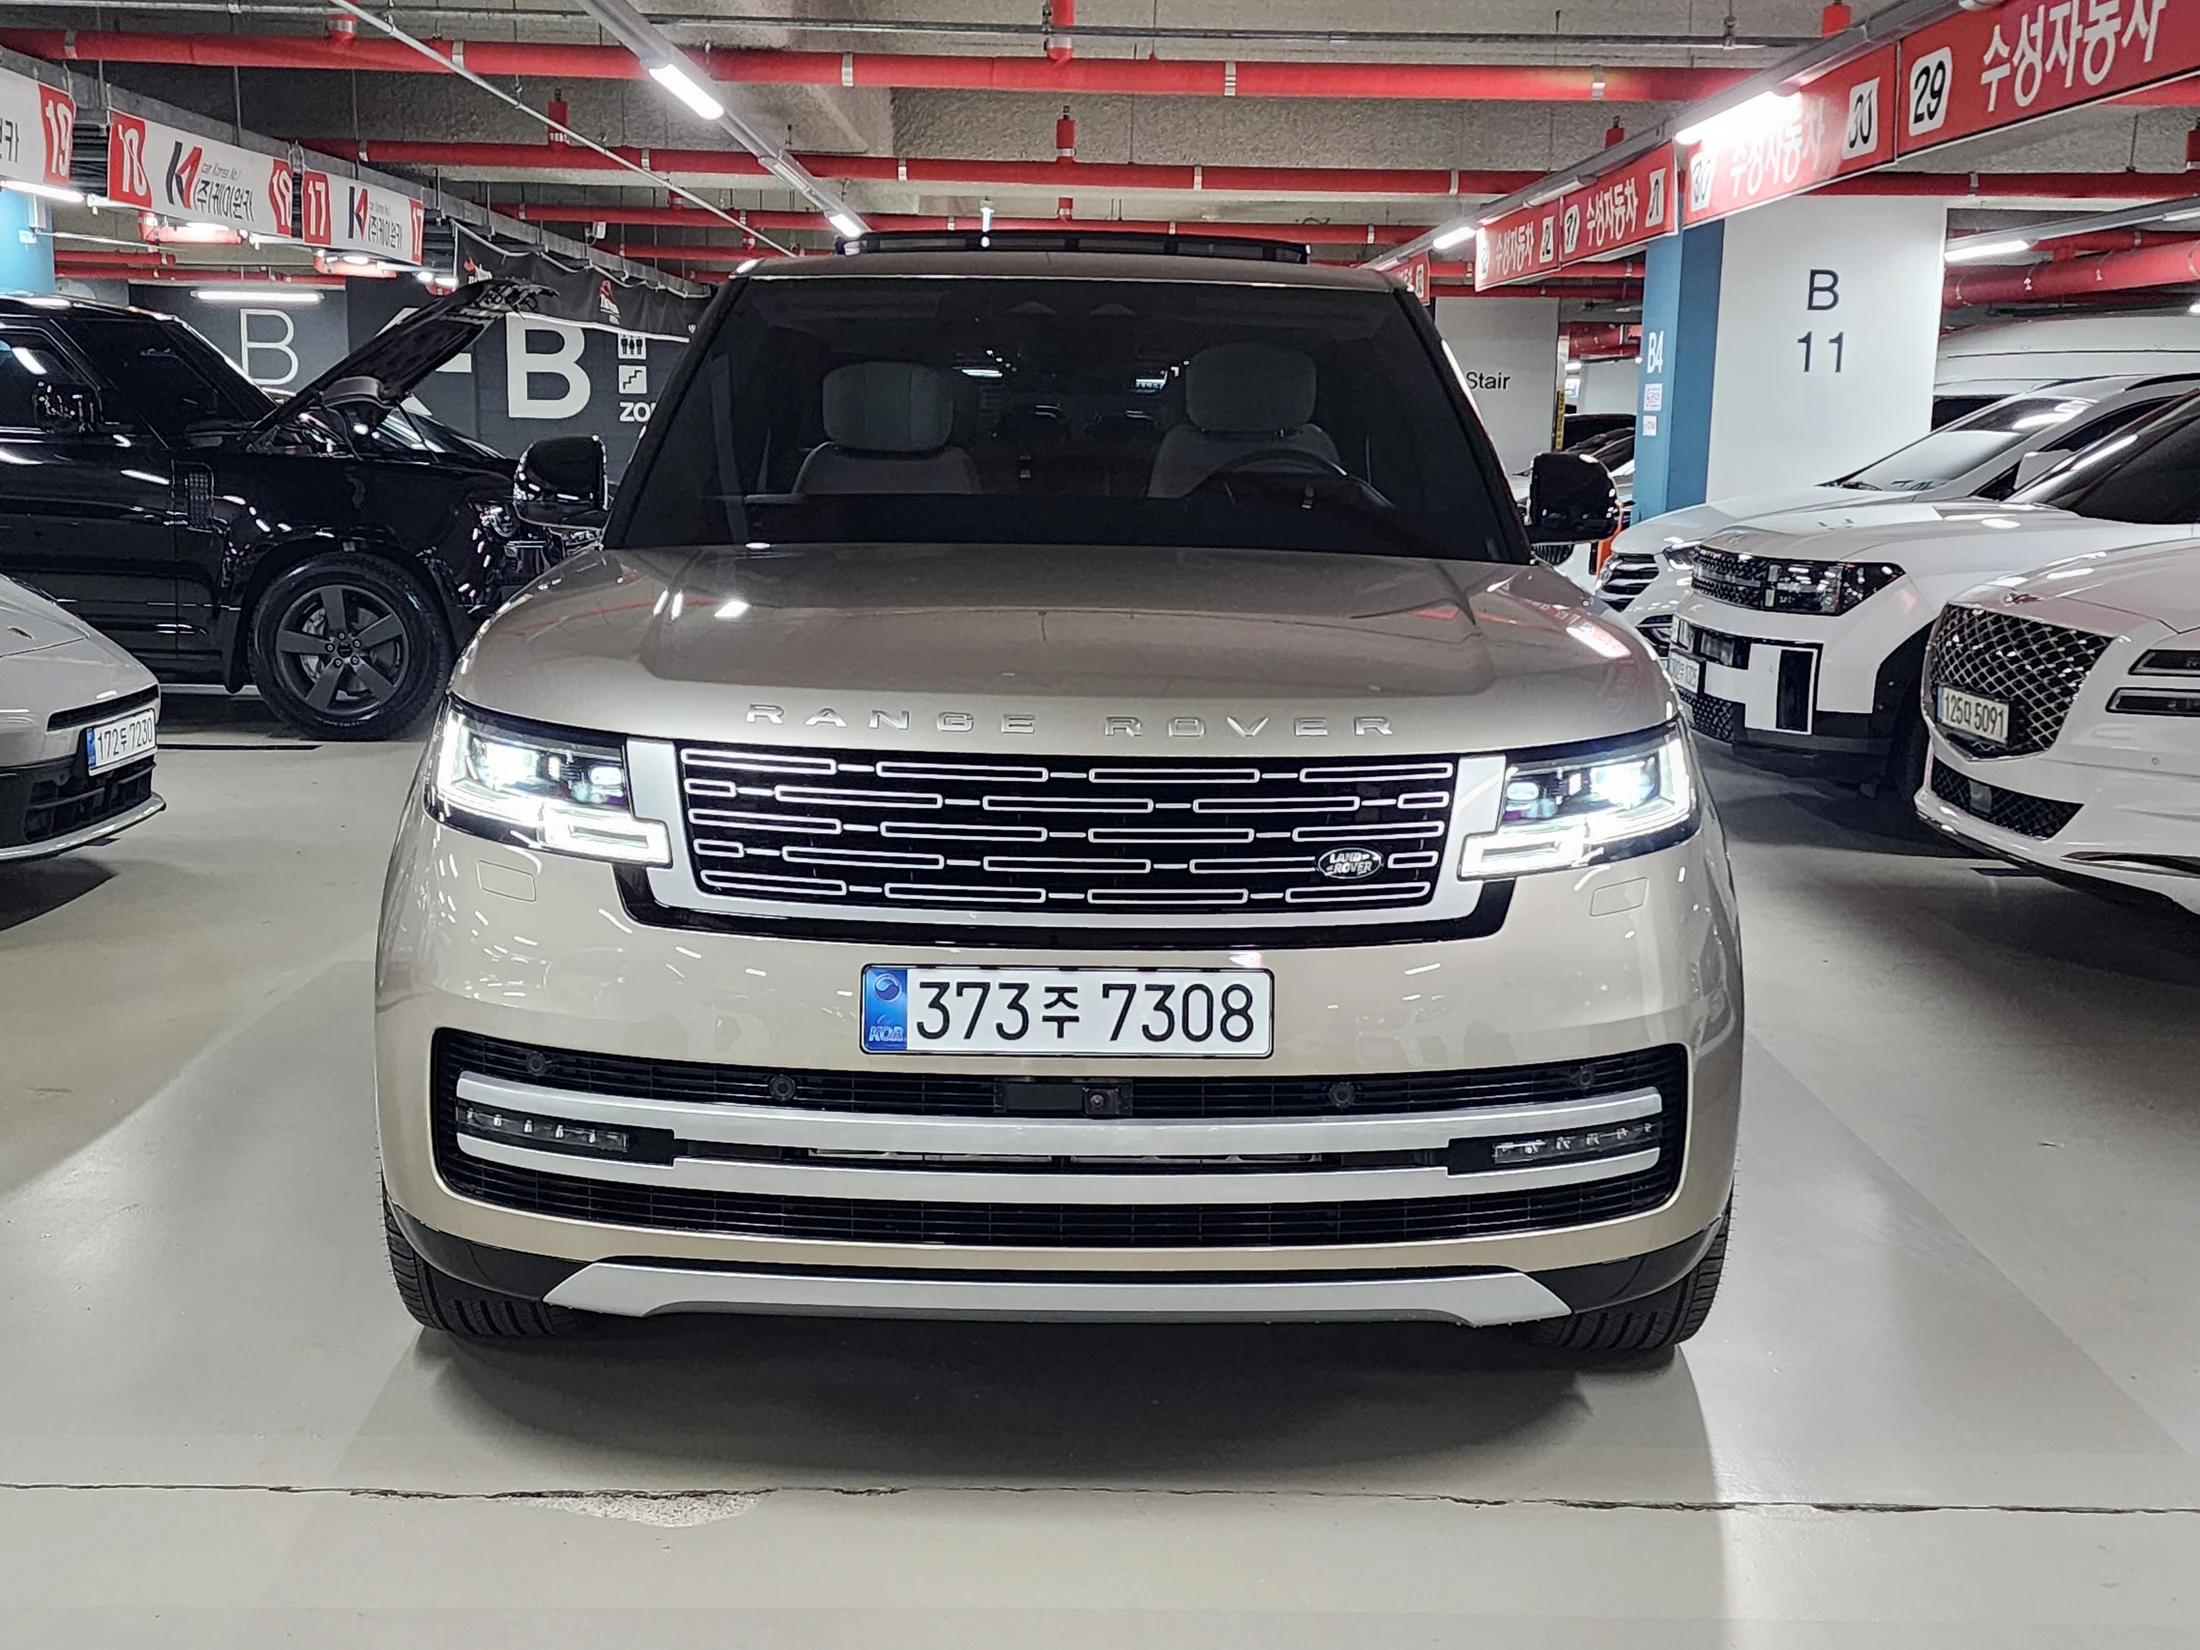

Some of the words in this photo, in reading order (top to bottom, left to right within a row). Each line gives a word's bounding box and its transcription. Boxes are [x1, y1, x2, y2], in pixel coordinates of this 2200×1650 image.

[1849, 88, 1873, 149] 30
[1913, 60, 1946, 124] 29
[45, 99, 72, 177] 19
[118, 124, 147, 197] 18
[307, 180, 326, 237] 17
[1586, 176, 1639, 247] 수성자동차
[1806, 268, 1840, 311] B
[240, 308, 299, 386] B
[506, 312, 592, 419] B
[1646, 330, 1665, 374] B4
[1796, 331, 1845, 373] 11
[1466, 371, 1511, 390] Stair
[129, 716, 153, 750] 7230
[745, 703, 1037, 735] RANGE
[1103, 714, 1394, 738] ROVER
[1974, 701, 2005, 738] 5091
[915, 981, 1080, 1041] 373주
[1101, 982, 1254, 1043] 7308
